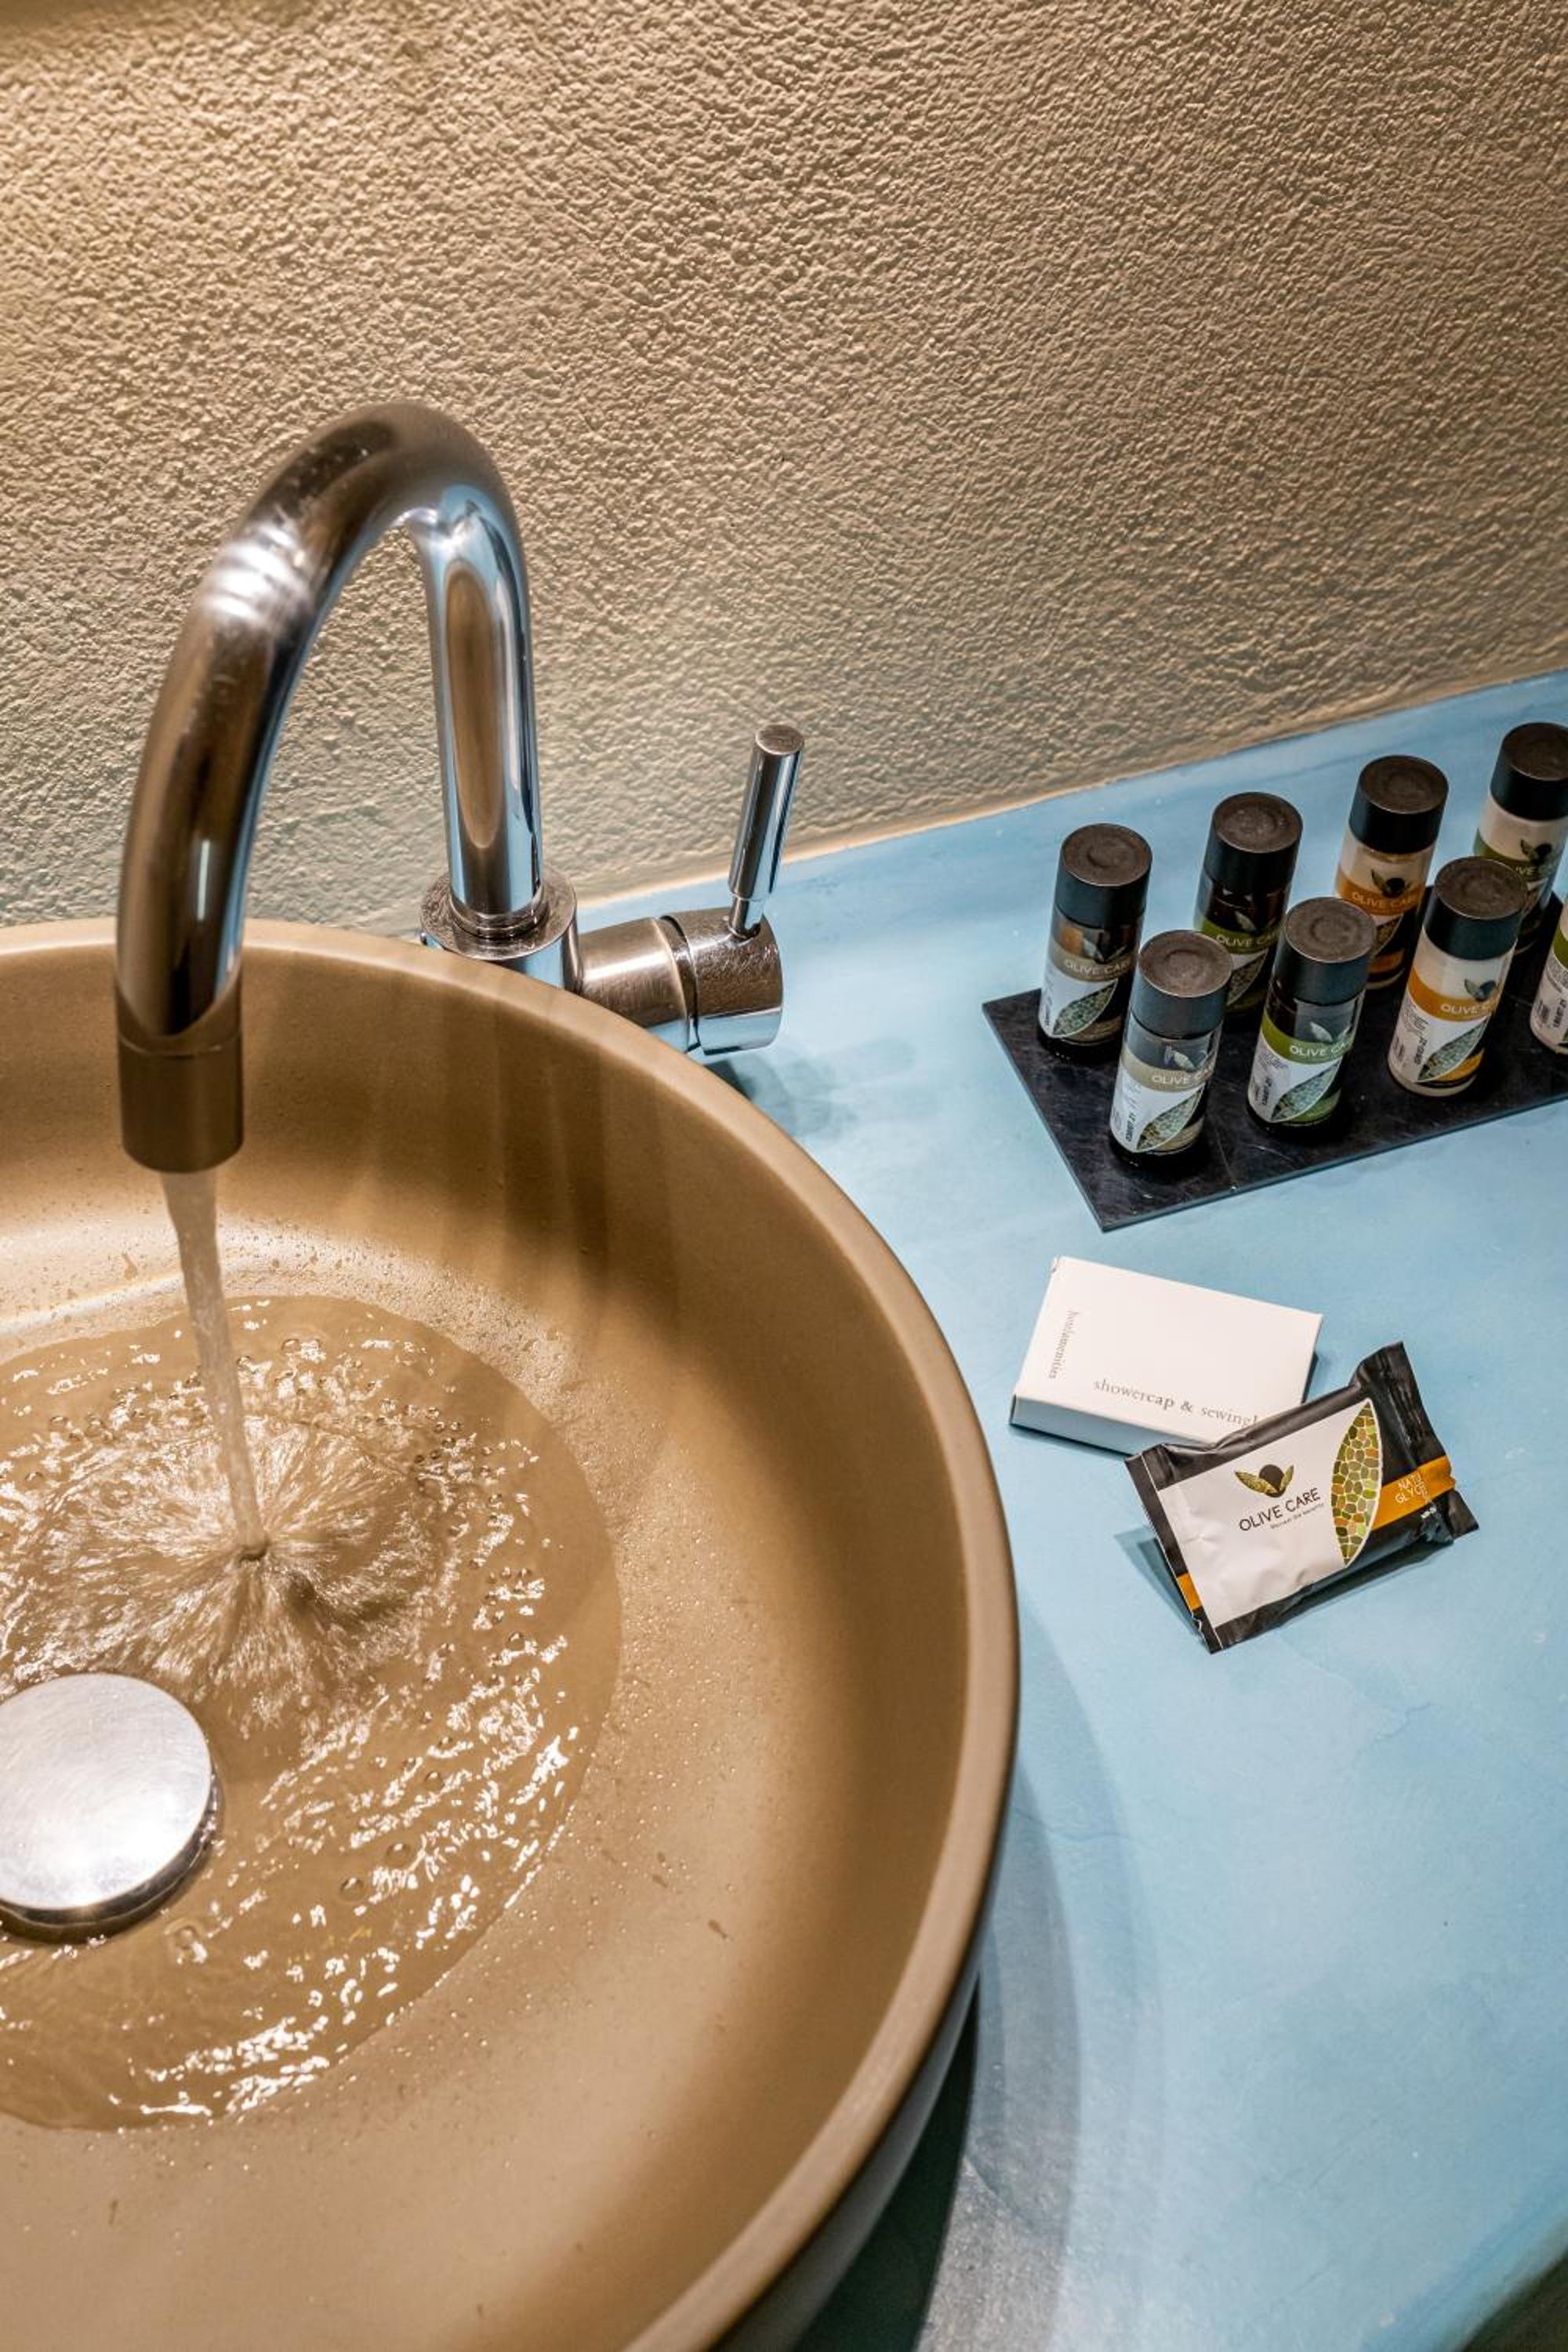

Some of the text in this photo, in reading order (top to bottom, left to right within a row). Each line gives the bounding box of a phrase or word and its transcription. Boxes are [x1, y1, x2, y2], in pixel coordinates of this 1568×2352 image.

[1352, 891, 1386, 908] OLIVE
[1216, 934, 1254, 948] OLIVE
[1065, 958, 1101, 975] OLIVE
[1440, 1003, 1478, 1014] OLIVE
[1290, 1044, 1326, 1057] OLIVE
[1151, 1074, 1191, 1085] OLIVE
[1093, 1378, 1175, 1410] showercap
[1181, 1400, 1193, 1414] &
[1239, 1504, 1283, 1531] OLIVE
[1284, 1487, 1321, 1513] CARE
